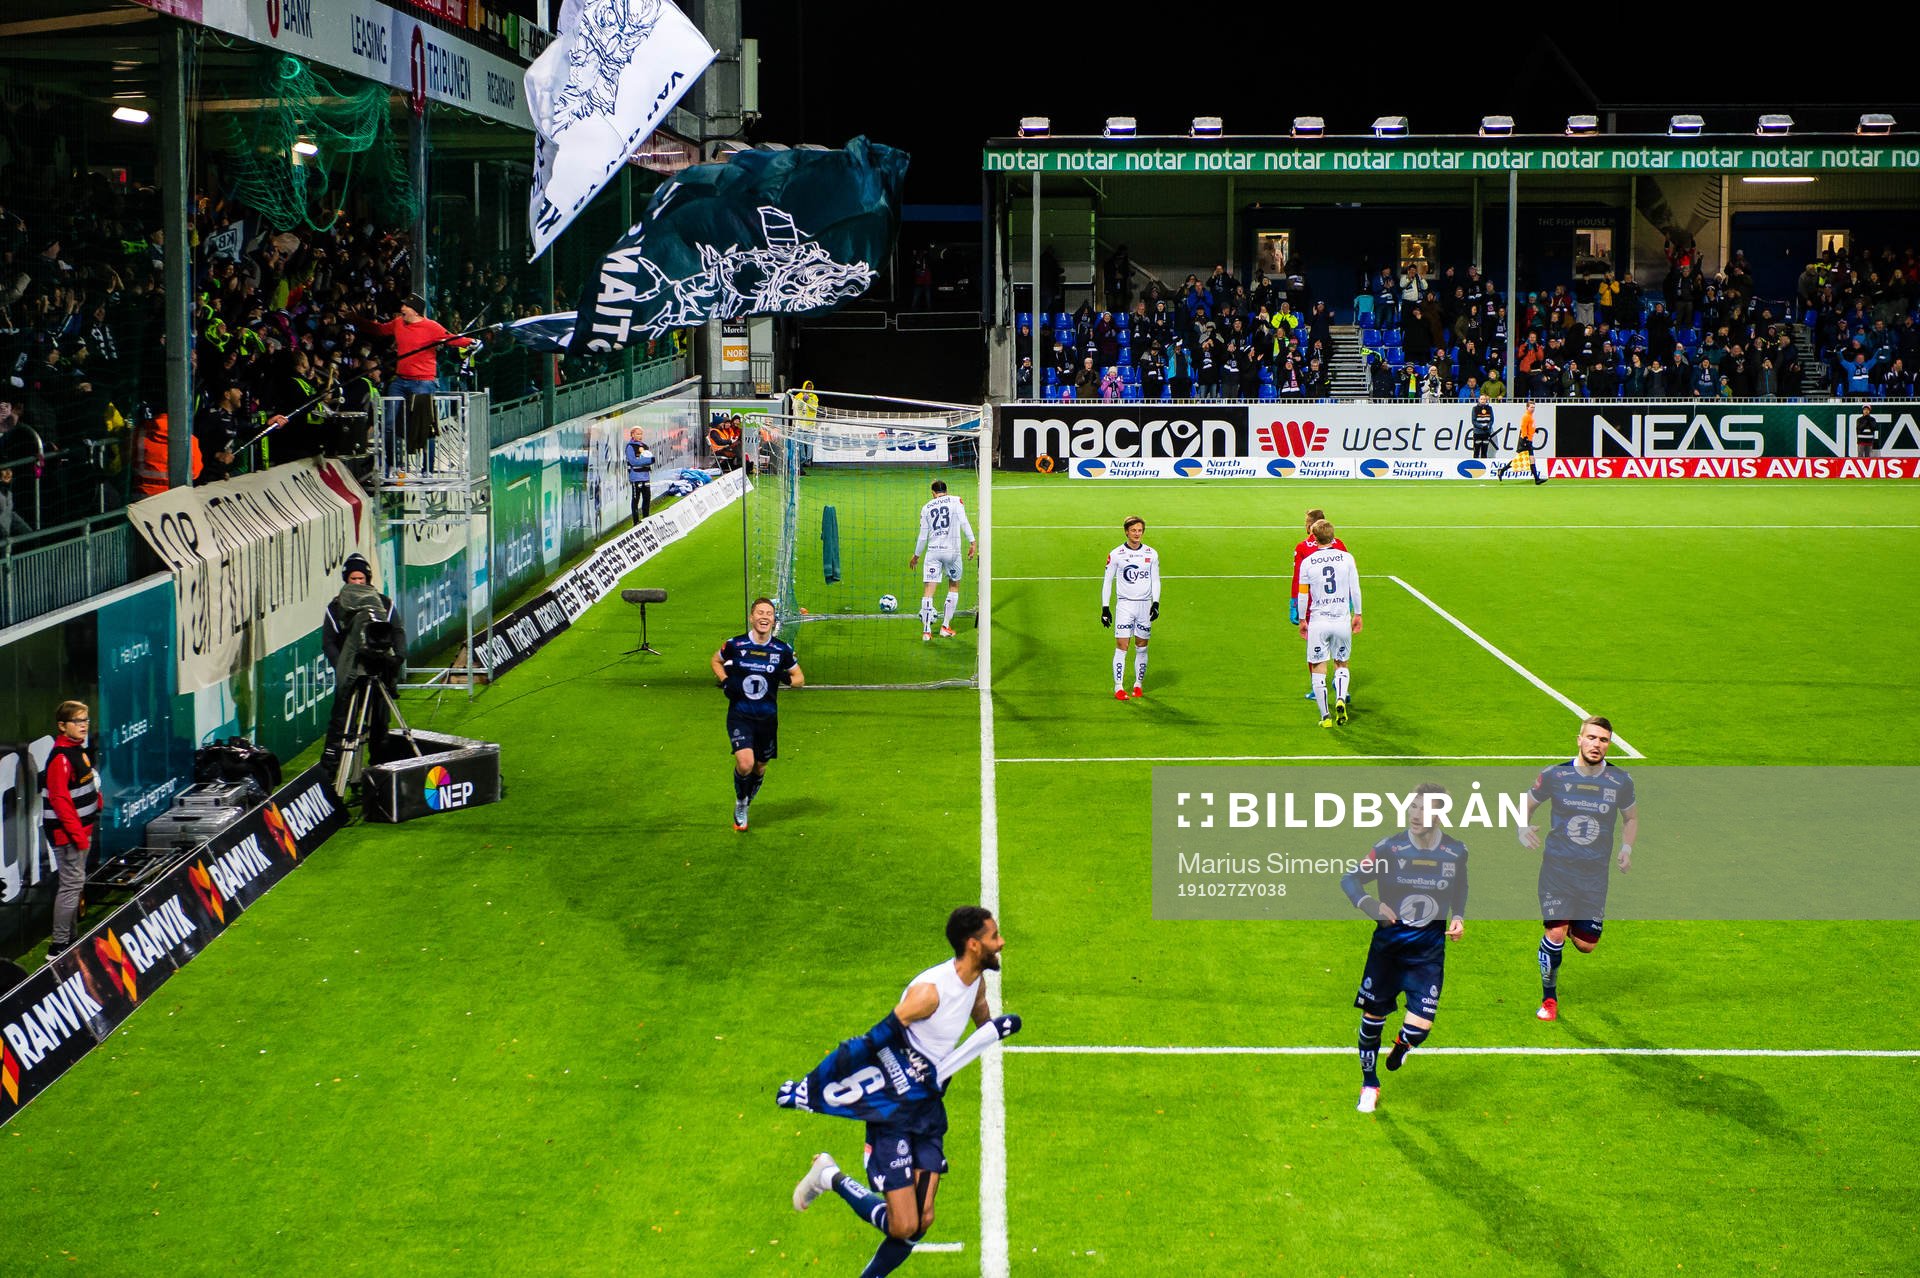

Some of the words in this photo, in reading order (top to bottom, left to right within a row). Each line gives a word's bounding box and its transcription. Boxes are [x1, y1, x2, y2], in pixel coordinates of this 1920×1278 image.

[283, 0, 313, 38] BANK
[351, 14, 387, 64] LEASING
[427, 43, 471, 101] TRIBUNEN
[988, 148, 1048, 170] notar
[1057, 148, 1118, 170] notar
[1126, 148, 1186, 170] notar
[1195, 148, 1255, 170] notar
[1264, 147, 1325, 169] notar
[1334, 147, 1395, 169] notar
[1403, 147, 1464, 169] notar
[1472, 147, 1534, 169] notar
[1542, 147, 1603, 169] notar
[1612, 146, 1673, 168] notar
[1682, 146, 1743, 168] notar
[1752, 146, 1813, 168] notar
[1822, 146, 1883, 168] notar
[1343, 422, 1426, 451] west
[1593, 414, 1764, 458] NEAS
[1109, 468, 1160, 478] Shipping
[1110, 460, 1145, 468] North
[1205, 468, 1256, 478] Shipping
[1207, 459, 1241, 468] North
[1299, 468, 1350, 478] Shipping
[1300, 460, 1334, 468] North
[1392, 468, 1443, 478] Shipping
[1393, 460, 1427, 468] North
[1550, 458, 1614, 478] AVIS
[1622, 458, 1687, 478] AVIS
[1694, 458, 1758, 478] AVIS
[1766, 458, 1831, 478] AVIS
[1839, 458, 1904, 478] AVIS
[930, 506, 950, 531] 23
[1311, 554, 1343, 565] bouvet
[1129, 569, 1149, 582] Lyse
[1322, 566, 1337, 594] 3
[439, 781, 474, 811] NEP
[1562, 798, 1599, 809] SpareBank
[281, 782, 335, 840] RAMVIK
[208, 833, 272, 901] RAMVIK
[1396, 876, 1437, 886] SpareBank
[121, 894, 197, 973] RAMVIK
[3, 971, 103, 1071] RAMVIK
